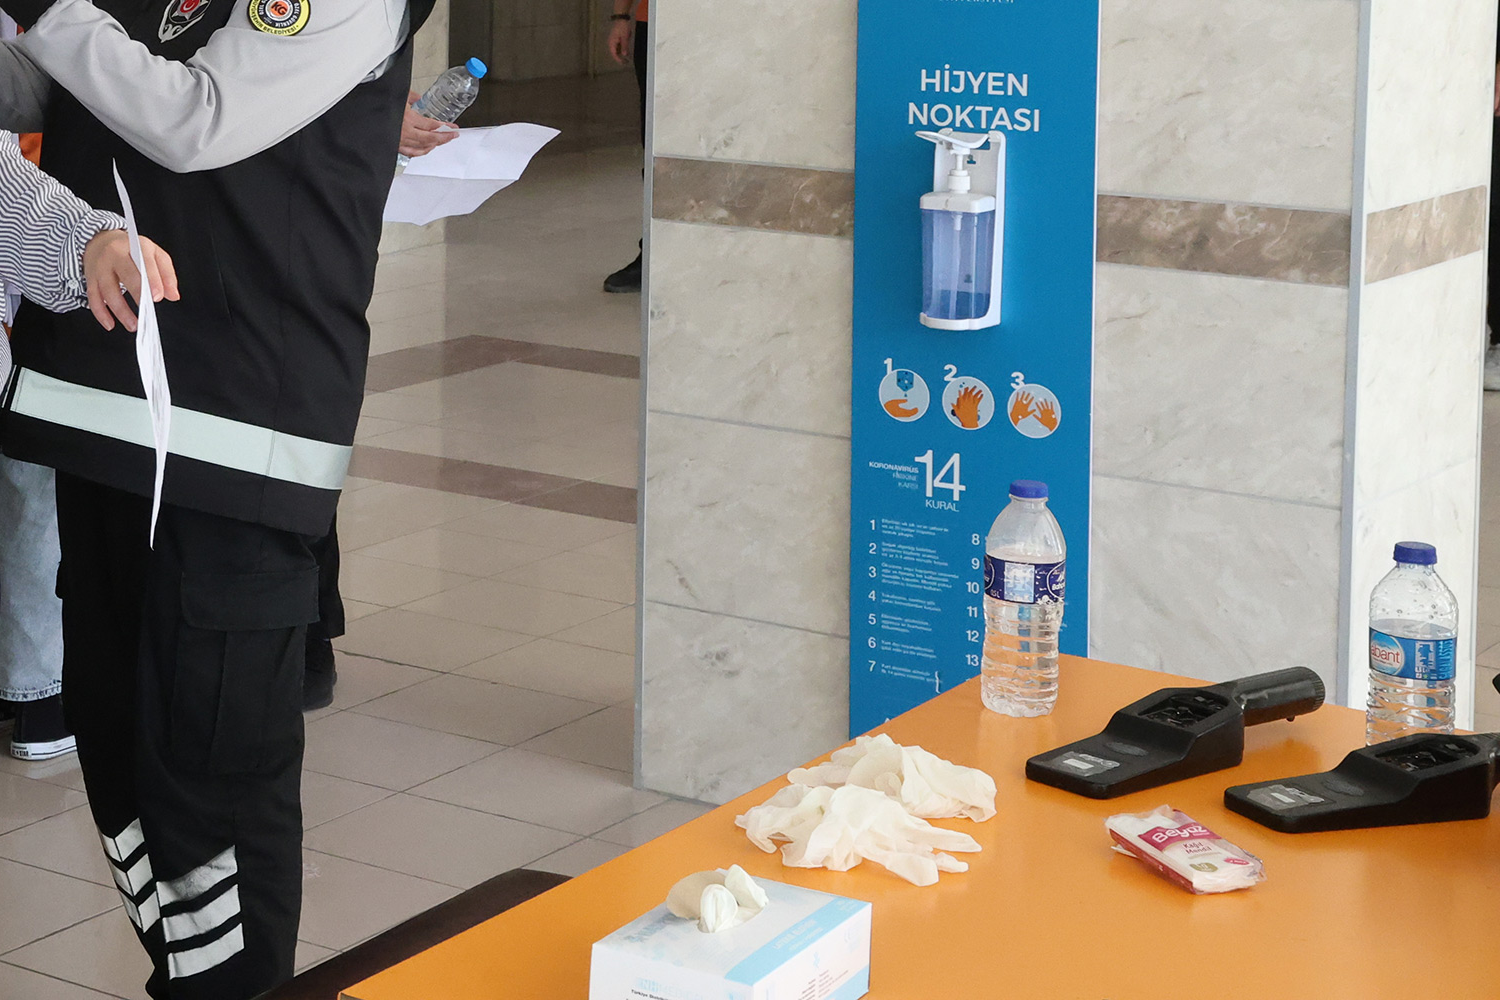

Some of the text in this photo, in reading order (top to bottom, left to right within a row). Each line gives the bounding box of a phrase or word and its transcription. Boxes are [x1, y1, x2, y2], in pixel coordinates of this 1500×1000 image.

[271, 1, 288, 16] KG
[920, 63, 1029, 97] HİJYEN
[908, 101, 1040, 133] NOKTASI
[884, 357, 893, 374] 1
[943, 364, 958, 382] 2
[1010, 371, 1025, 389] 3
[914, 449, 966, 502] 14
[925, 499, 960, 513] KURAL
[869, 519, 876, 531] 1
[971, 533, 980, 546] 8
[868, 542, 877, 554] 2
[971, 557, 980, 570] 9
[868, 566, 877, 578] 3
[965, 581, 980, 594] 10
[868, 590, 876, 601] 4
[966, 605, 978, 618] 11
[868, 613, 877, 625] 5
[867, 636, 877, 649] 6
[965, 629, 980, 643] 12
[868, 660, 877, 672] 7
[965, 654, 980, 667] 13
[1152, 825, 1208, 843] Beyaz
